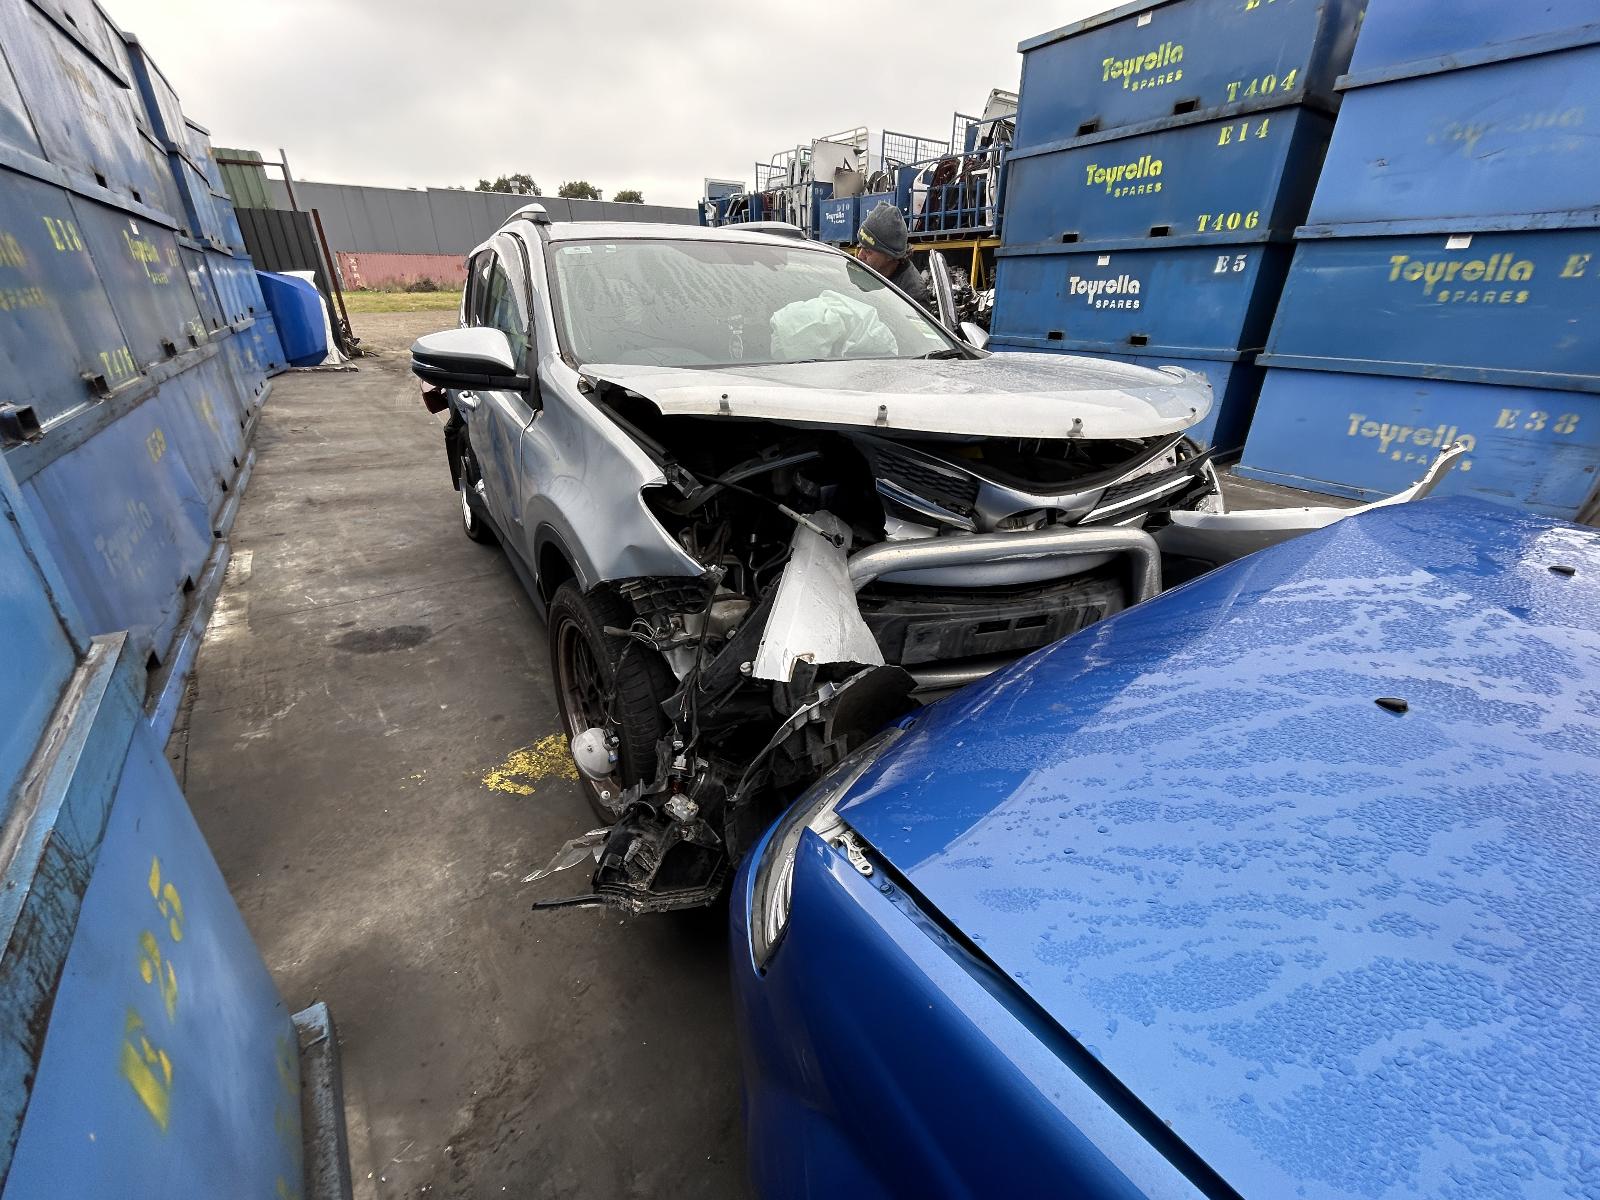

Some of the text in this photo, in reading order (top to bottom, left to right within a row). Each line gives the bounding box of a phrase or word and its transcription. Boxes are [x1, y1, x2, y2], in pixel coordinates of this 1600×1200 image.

[1102, 41, 1184, 89] Toyrolla
[1131, 69, 1183, 92] SPARES
[1226, 69, 1297, 102] T404
[1217, 118, 1270, 146] E14
[1086, 155, 1163, 194] Toyrolla
[1114, 182, 1163, 198] SPARES
[1197, 210, 1260, 232] T406
[1214, 254, 1248, 274] E5
[1389, 252, 1535, 296] Toyrolla
[1559, 252, 1600, 279] E
[1069, 274, 1141, 304] Toyrolla
[1437, 290, 1531, 304] SPARES
[1095, 299, 1140, 309] SPARES
[1347, 412, 1477, 454] Toyrolla
[1494, 408, 1581, 435] E38
[1391, 449, 1473, 473] SPAS
